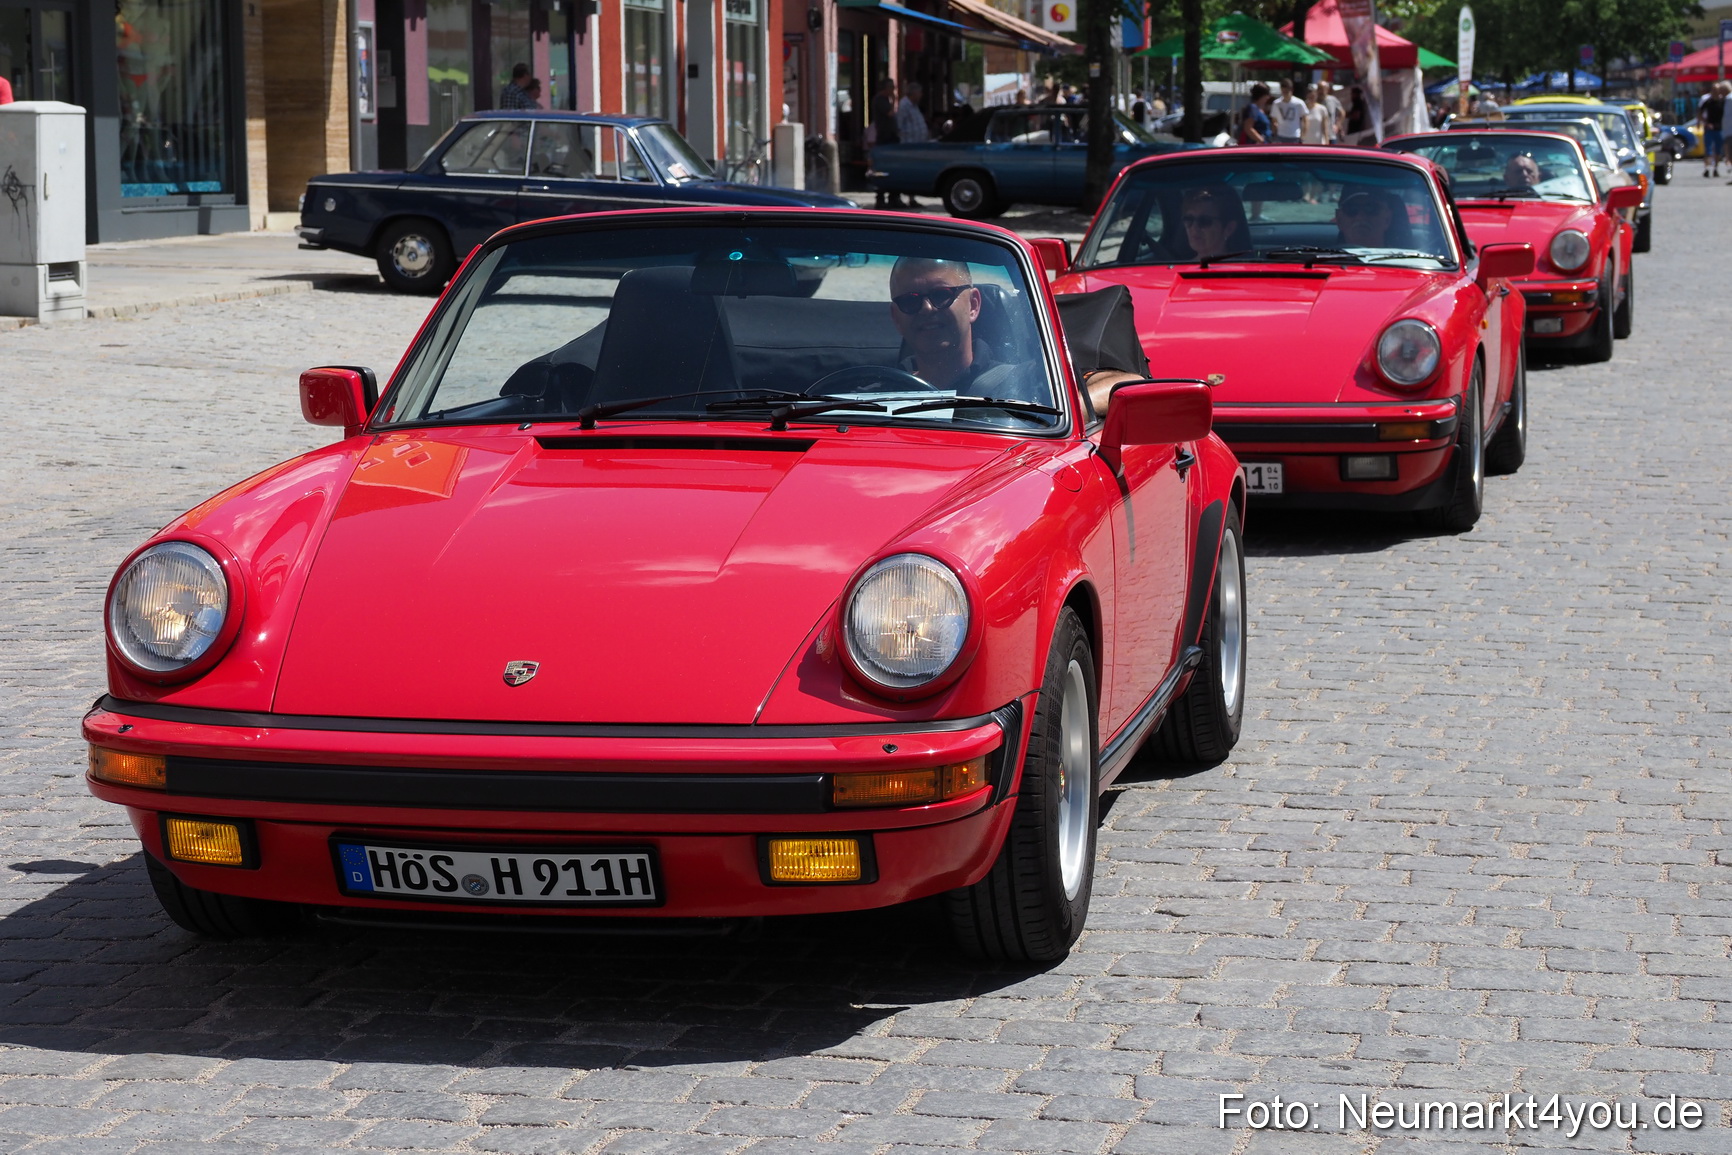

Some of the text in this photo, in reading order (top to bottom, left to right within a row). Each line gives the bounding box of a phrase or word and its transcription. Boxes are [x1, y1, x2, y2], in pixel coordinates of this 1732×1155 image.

[352, 871, 363, 882] D
[491, 857, 523, 896] H
[532, 858, 652, 897] 911H
